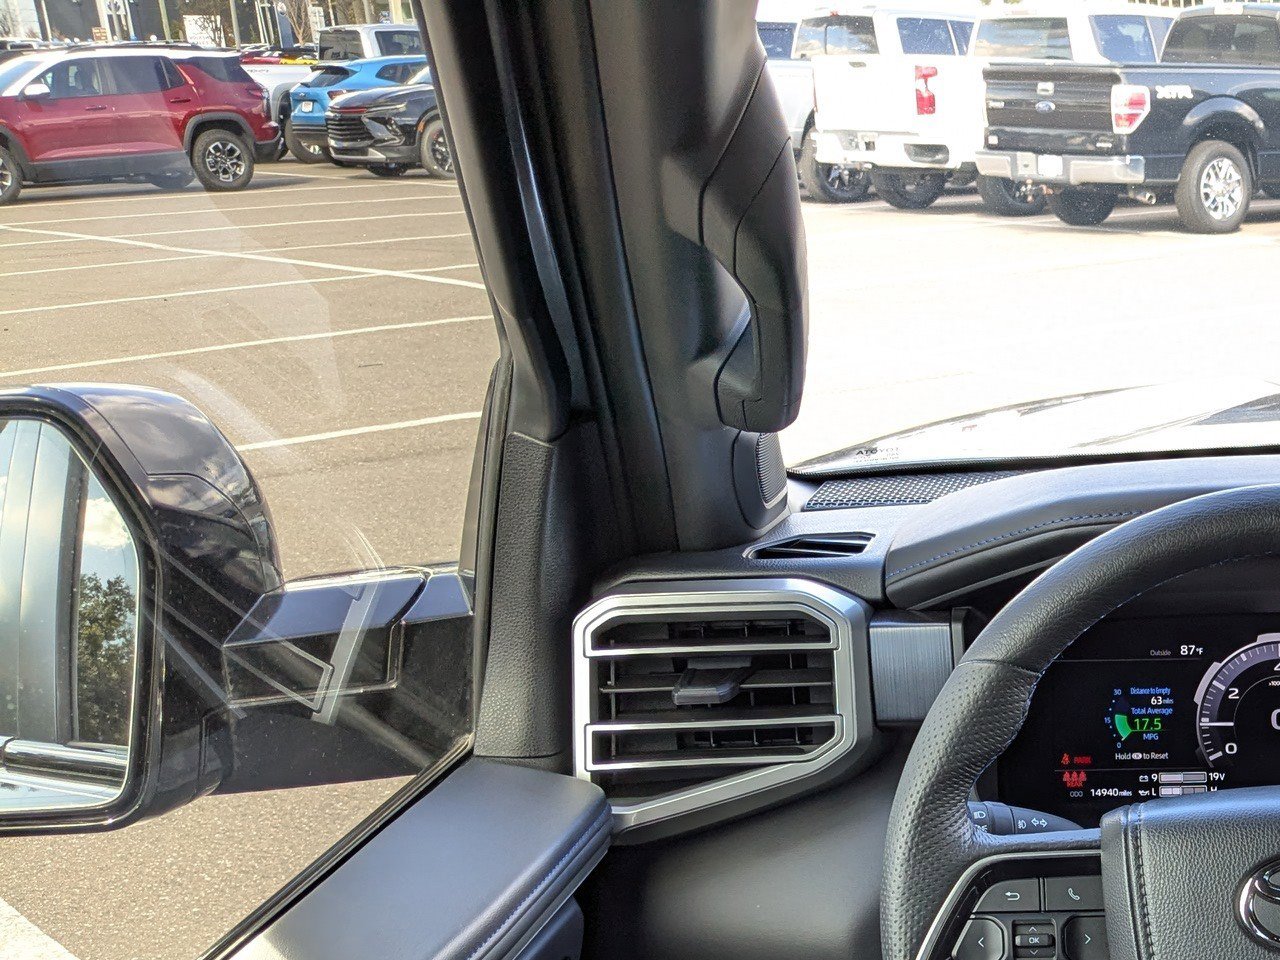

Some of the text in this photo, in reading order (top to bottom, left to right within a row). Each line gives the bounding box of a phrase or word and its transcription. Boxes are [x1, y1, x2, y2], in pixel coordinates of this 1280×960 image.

[1130, 687, 1150, 695] Distance
[1156, 687, 1171, 695] Empty
[1228, 688, 1239, 699] 2
[1151, 696, 1163, 705] 63
[1147, 707, 1173, 715] Average
[1134, 718, 1162, 731] 17.5
[1225, 742, 1237, 754] 0
[1151, 774, 1158, 782] 9
[1209, 773, 1225, 781] 19V
[1091, 788, 1119, 796] 14940
